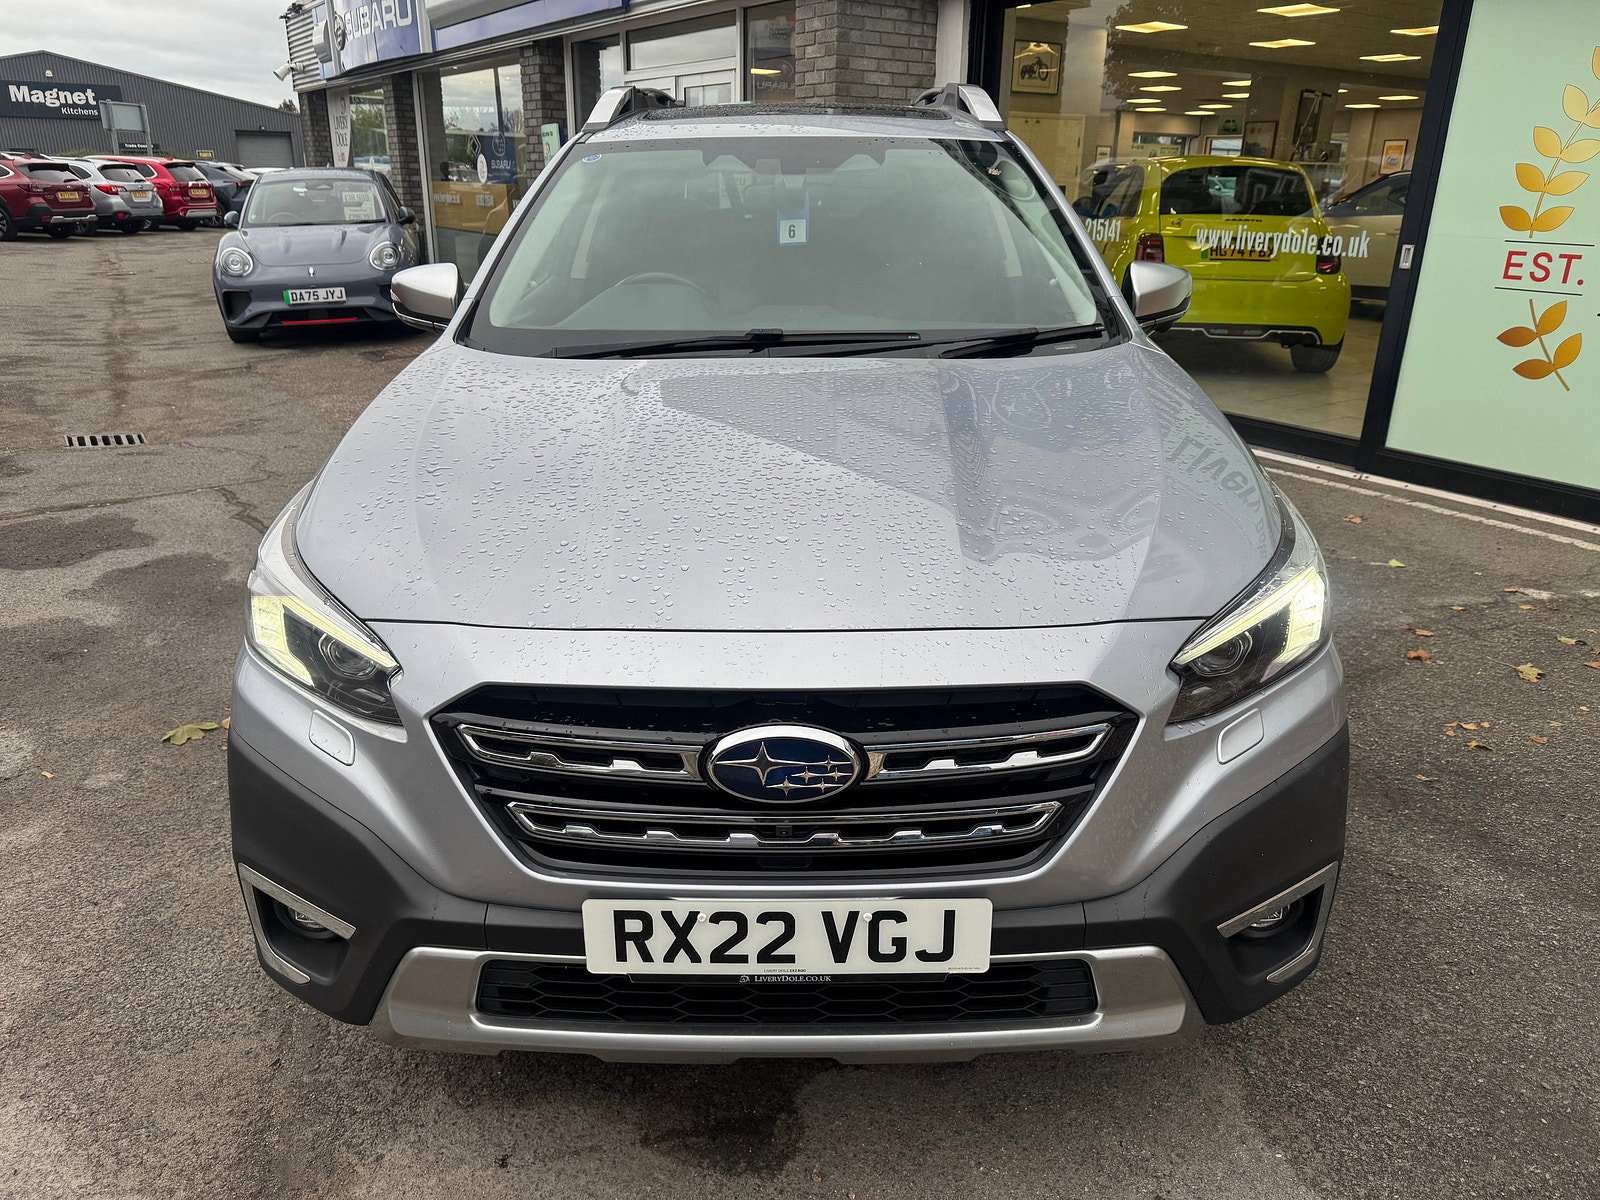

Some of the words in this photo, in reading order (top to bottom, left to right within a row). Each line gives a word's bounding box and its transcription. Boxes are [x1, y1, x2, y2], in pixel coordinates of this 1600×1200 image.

[344, 0, 412, 41] SUBARU
[8, 85, 97, 107] Magnet
[61, 107, 99, 116] Kitchens
[788, 224, 796, 239] 6
[1196, 224, 1371, 258] www.liverydole.co.uk
[1502, 251, 1585, 286] EST.
[290, 290, 320, 302] DA75
[322, 289, 344, 300] JYJ
[613, 910, 796, 964] RX22
[821, 910, 957, 964] VGJ
